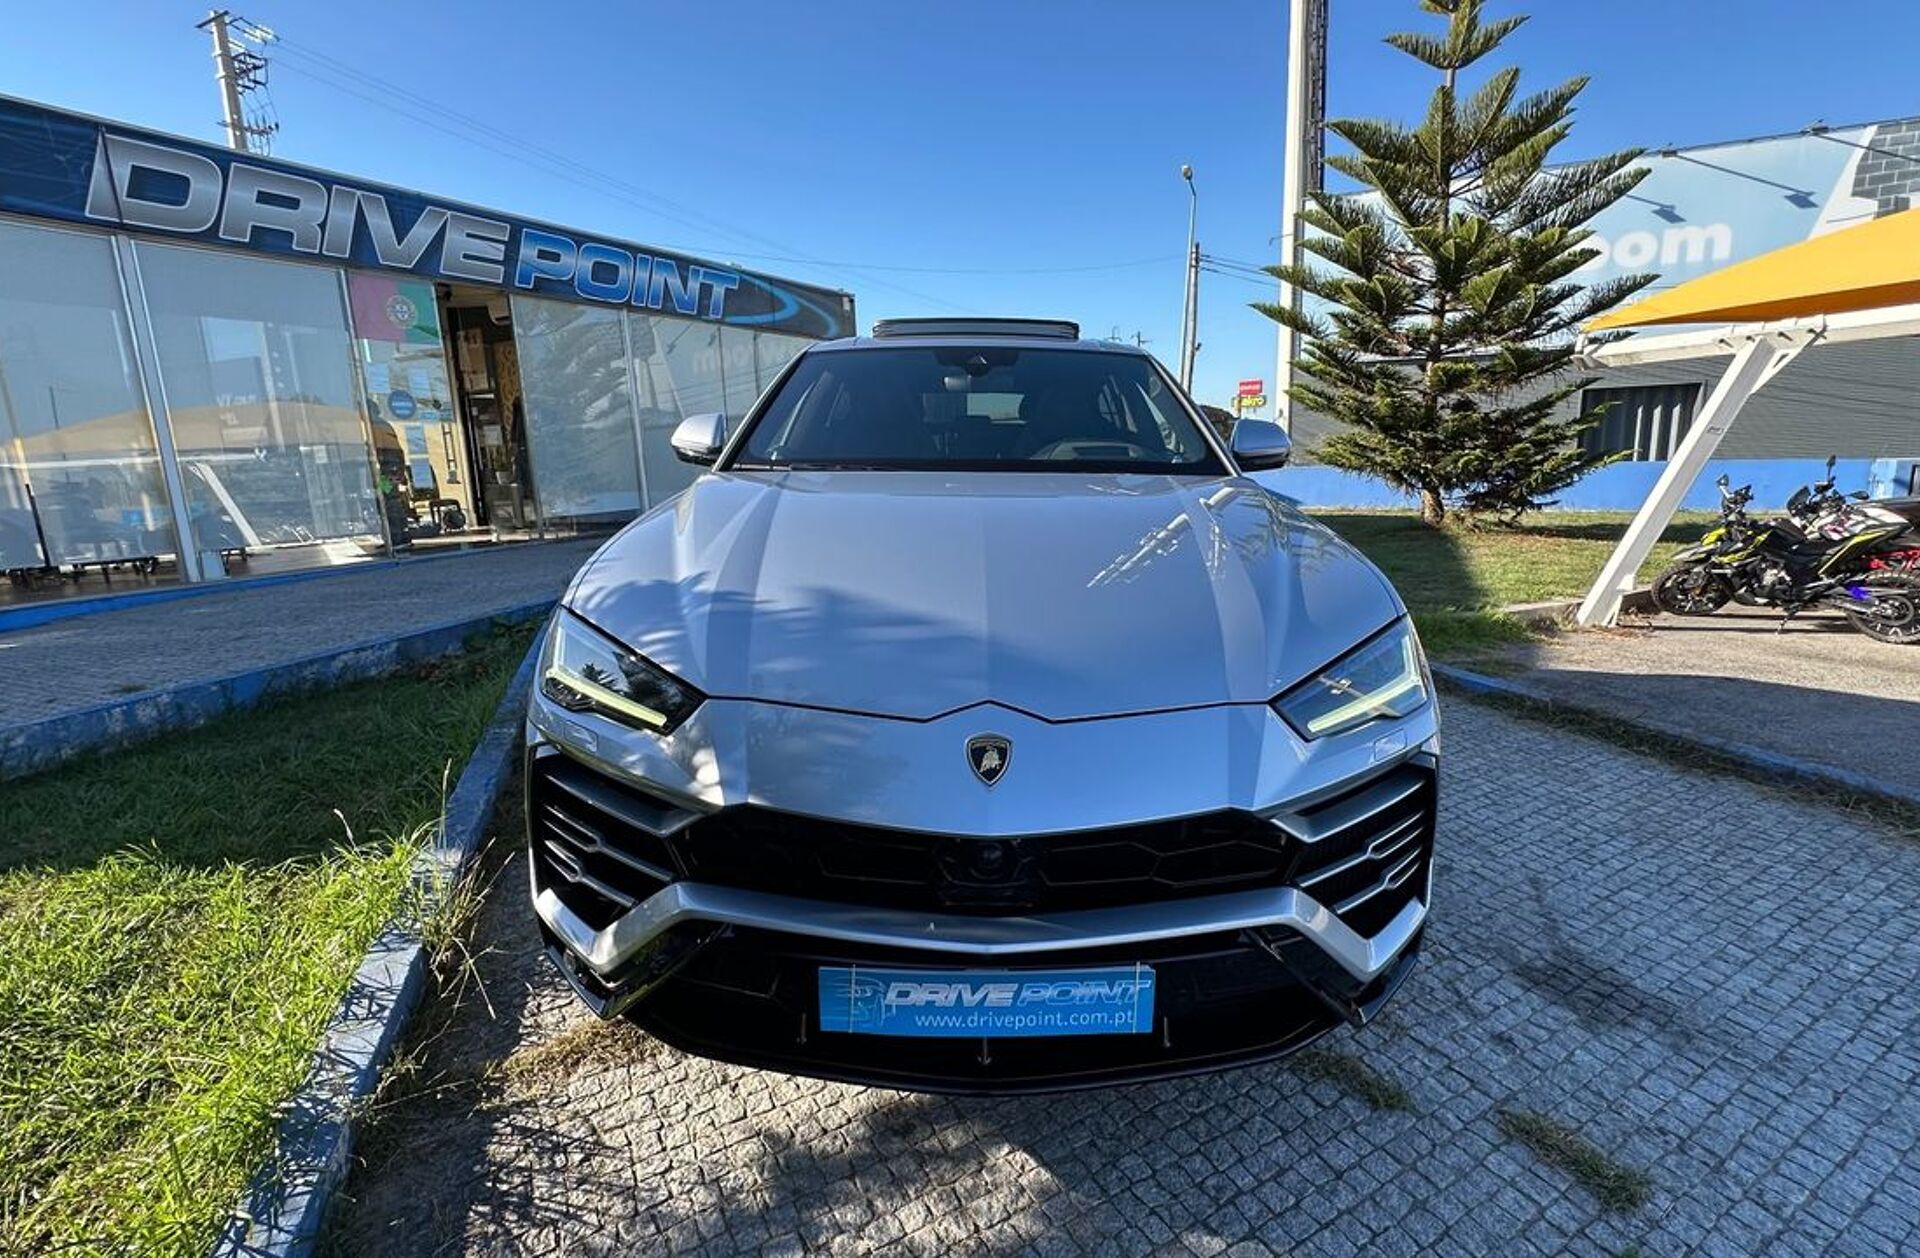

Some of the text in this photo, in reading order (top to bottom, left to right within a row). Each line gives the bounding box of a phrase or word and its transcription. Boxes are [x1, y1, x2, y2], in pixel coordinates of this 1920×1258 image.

[85, 133, 740, 319] DRIVE POINT
[883, 979, 1152, 1008] DRIVE POINT
[915, 1009, 1135, 1030] www.drivepoint.com.pt
